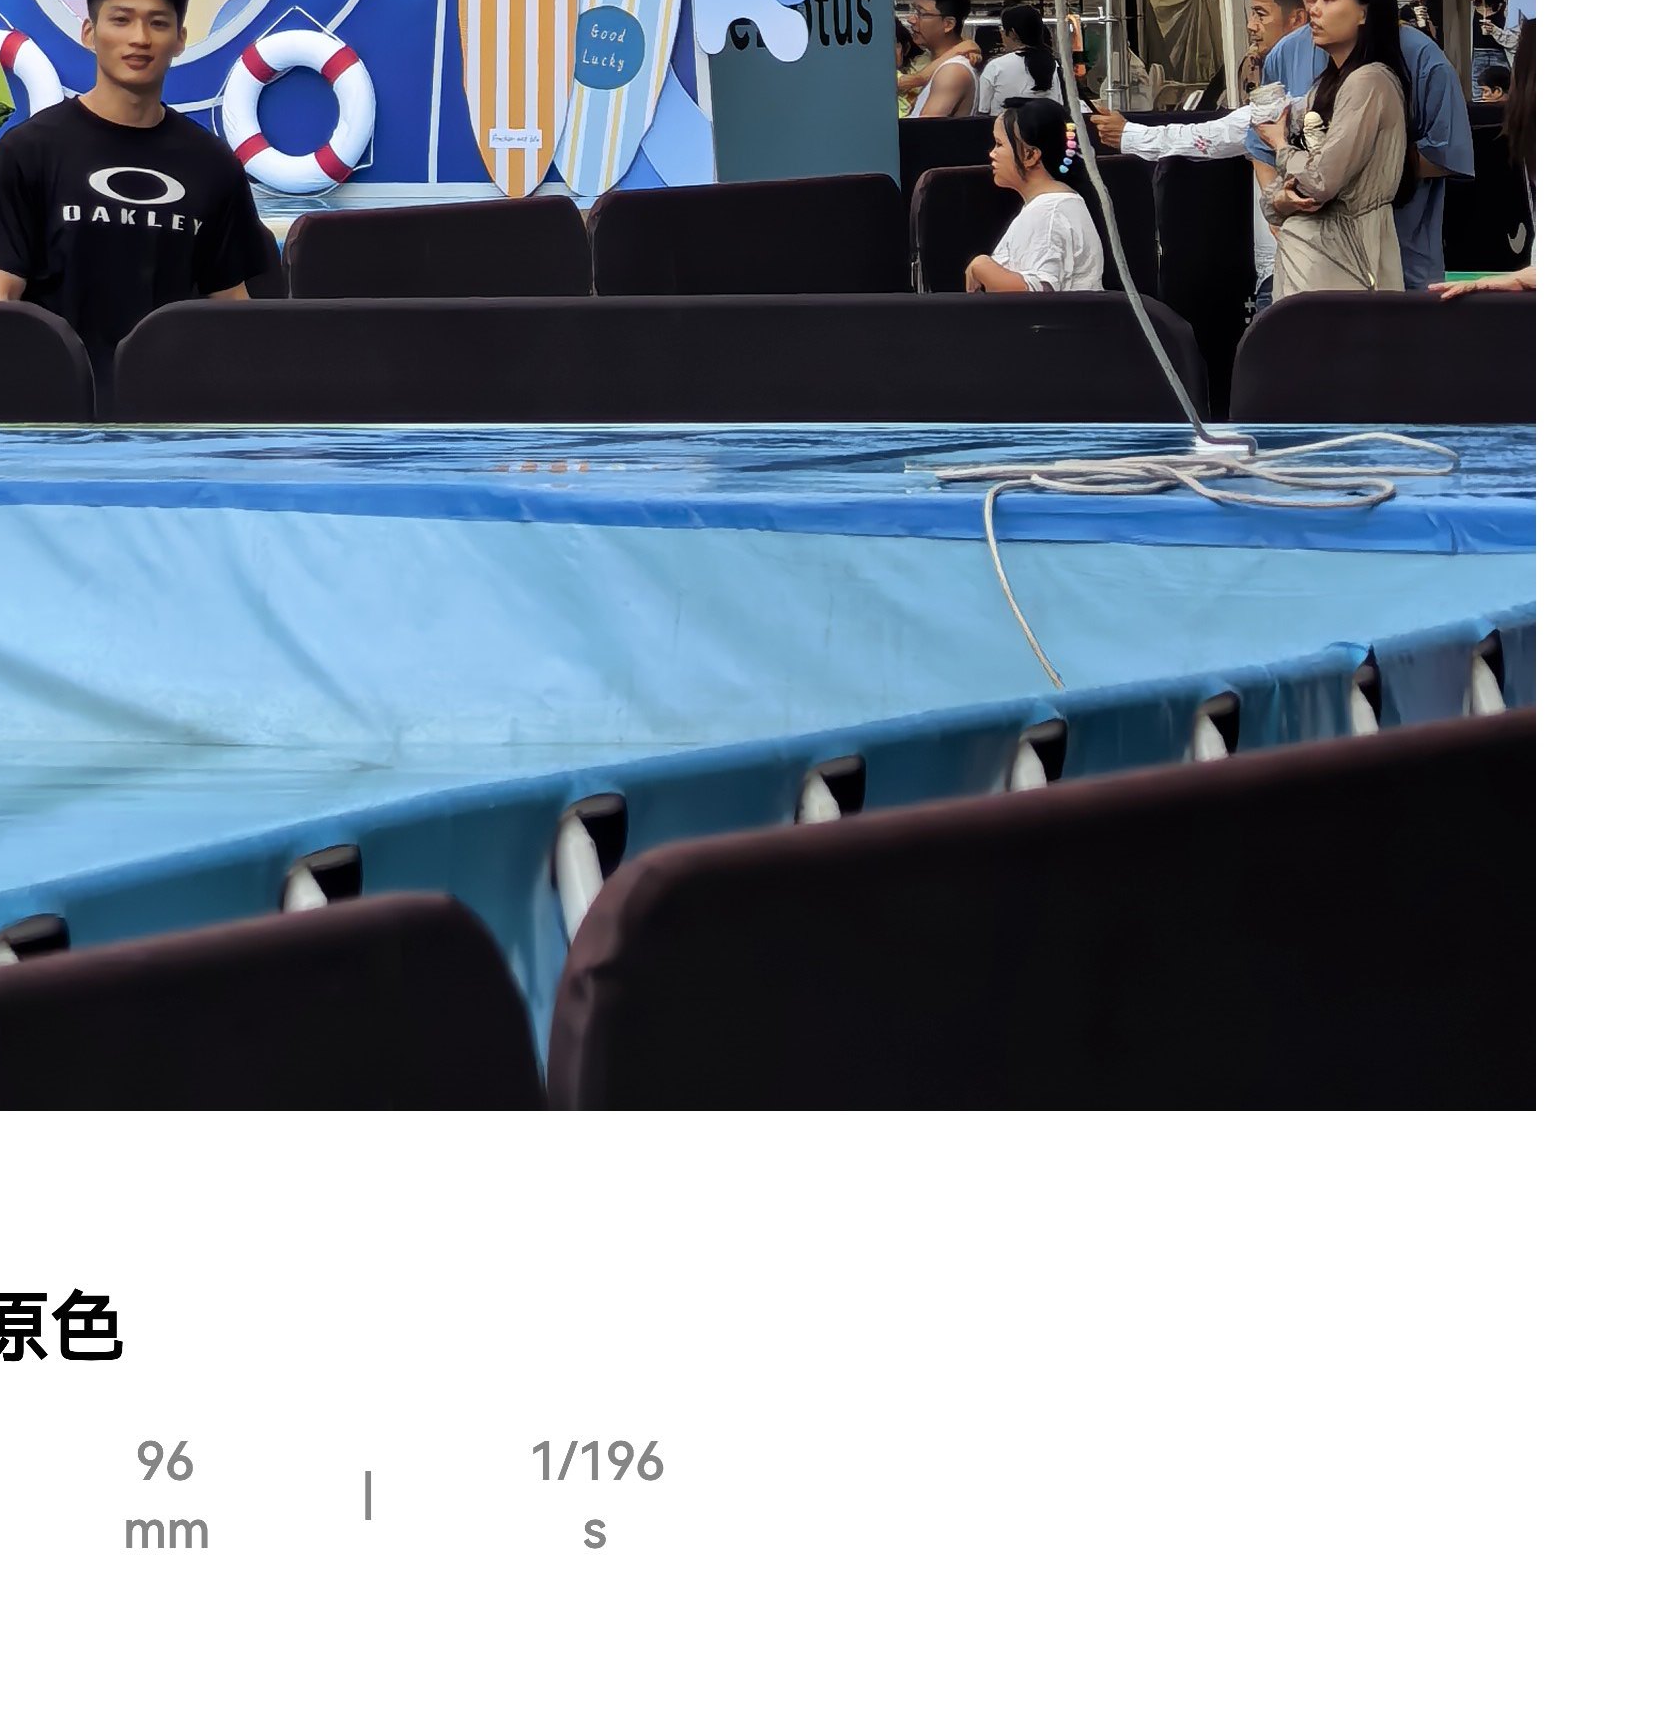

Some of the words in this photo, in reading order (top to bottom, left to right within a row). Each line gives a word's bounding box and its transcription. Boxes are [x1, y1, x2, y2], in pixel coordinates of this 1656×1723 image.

[590, 23, 627, 43] Good
[582, 48, 625, 72] Lucky
[62, 204, 203, 236] OAKLEY
